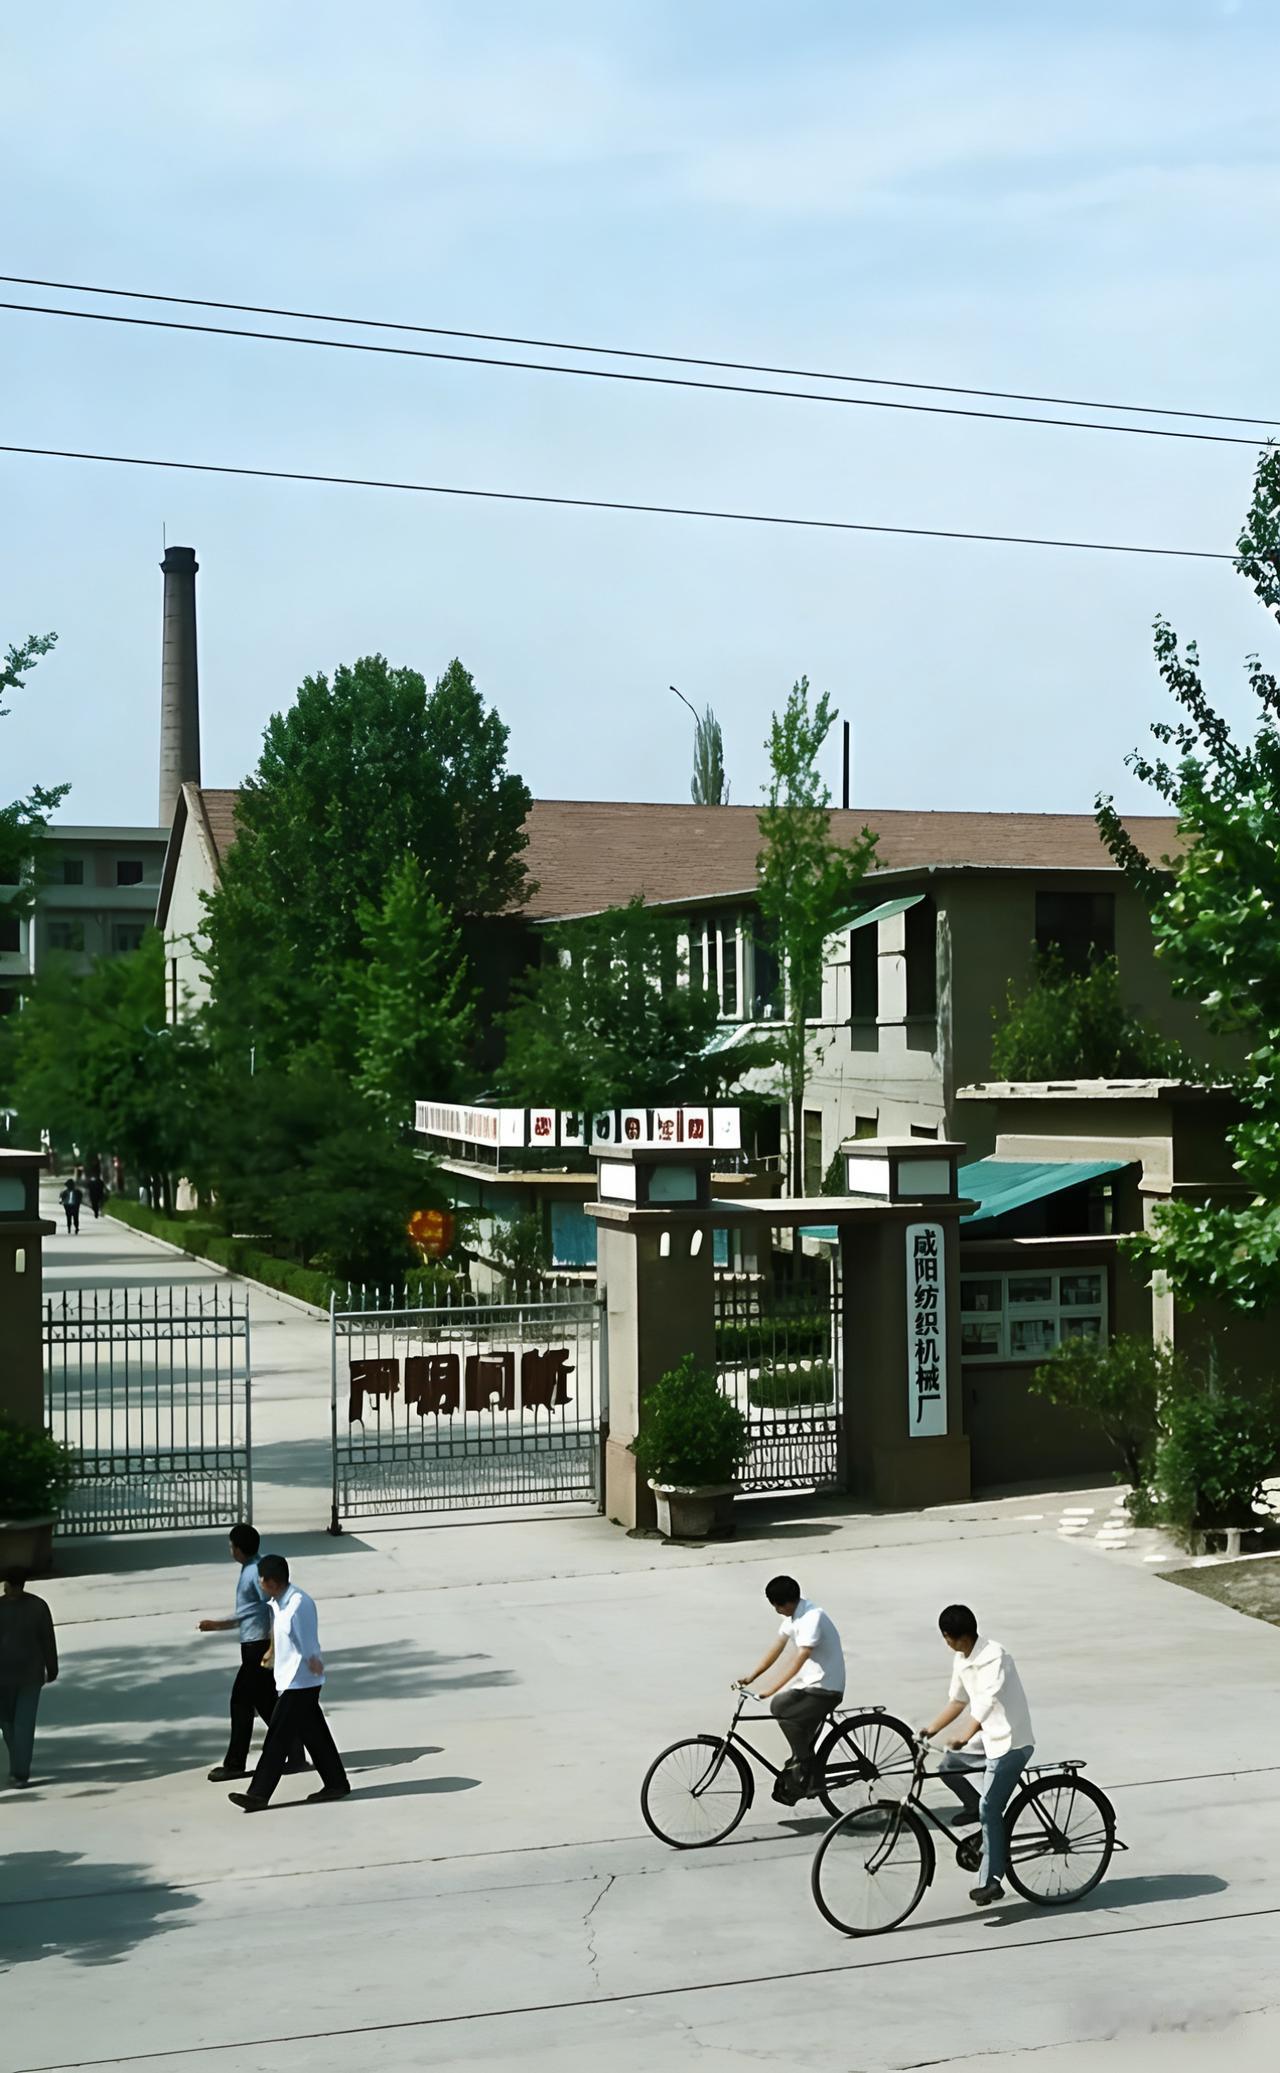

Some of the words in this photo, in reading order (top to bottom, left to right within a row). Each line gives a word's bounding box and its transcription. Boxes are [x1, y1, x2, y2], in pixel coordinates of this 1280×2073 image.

[913, 1229, 941, 1423] 咸阳纺织机械厂
